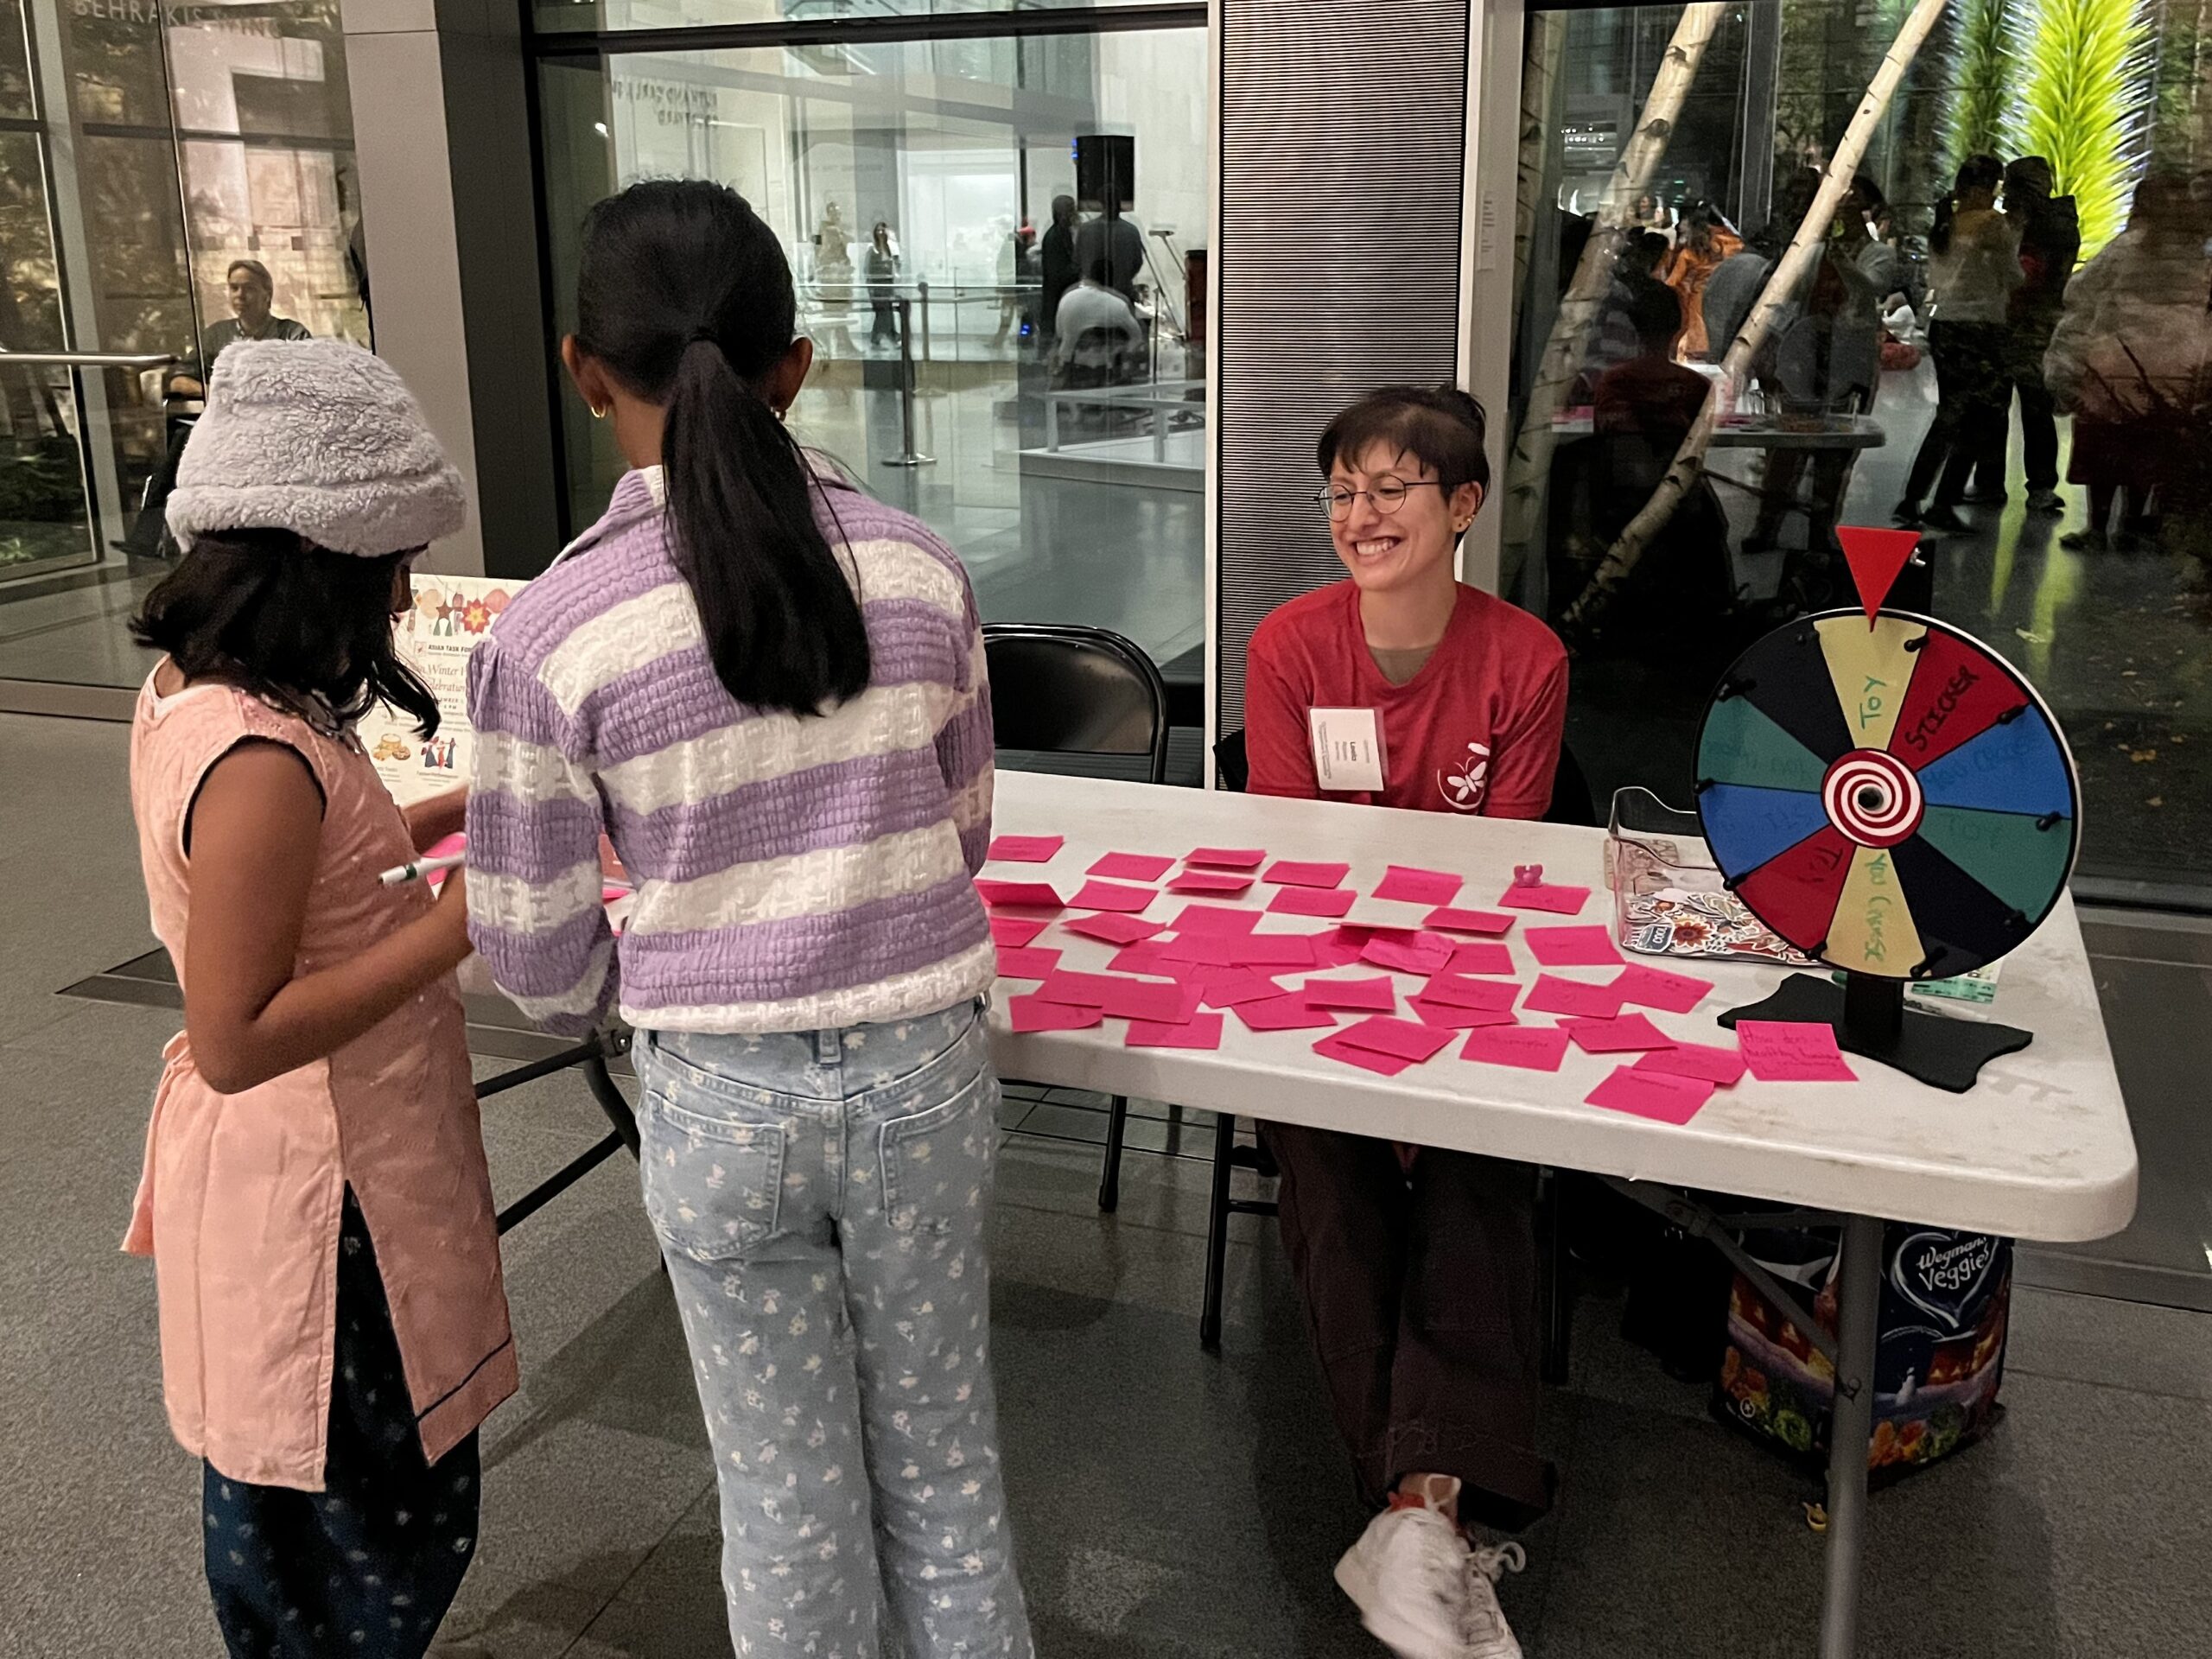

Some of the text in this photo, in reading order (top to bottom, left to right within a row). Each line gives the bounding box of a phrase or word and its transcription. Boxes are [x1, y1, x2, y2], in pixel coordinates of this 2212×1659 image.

[74, 0, 202, 25] BEHRAKIS
[429, 664, 459, 676] Winter
[1859, 675, 1887, 729] TOY
[1916, 1236, 1987, 1270] Wegmans
[1918, 1243, 1990, 1292] Veggies
